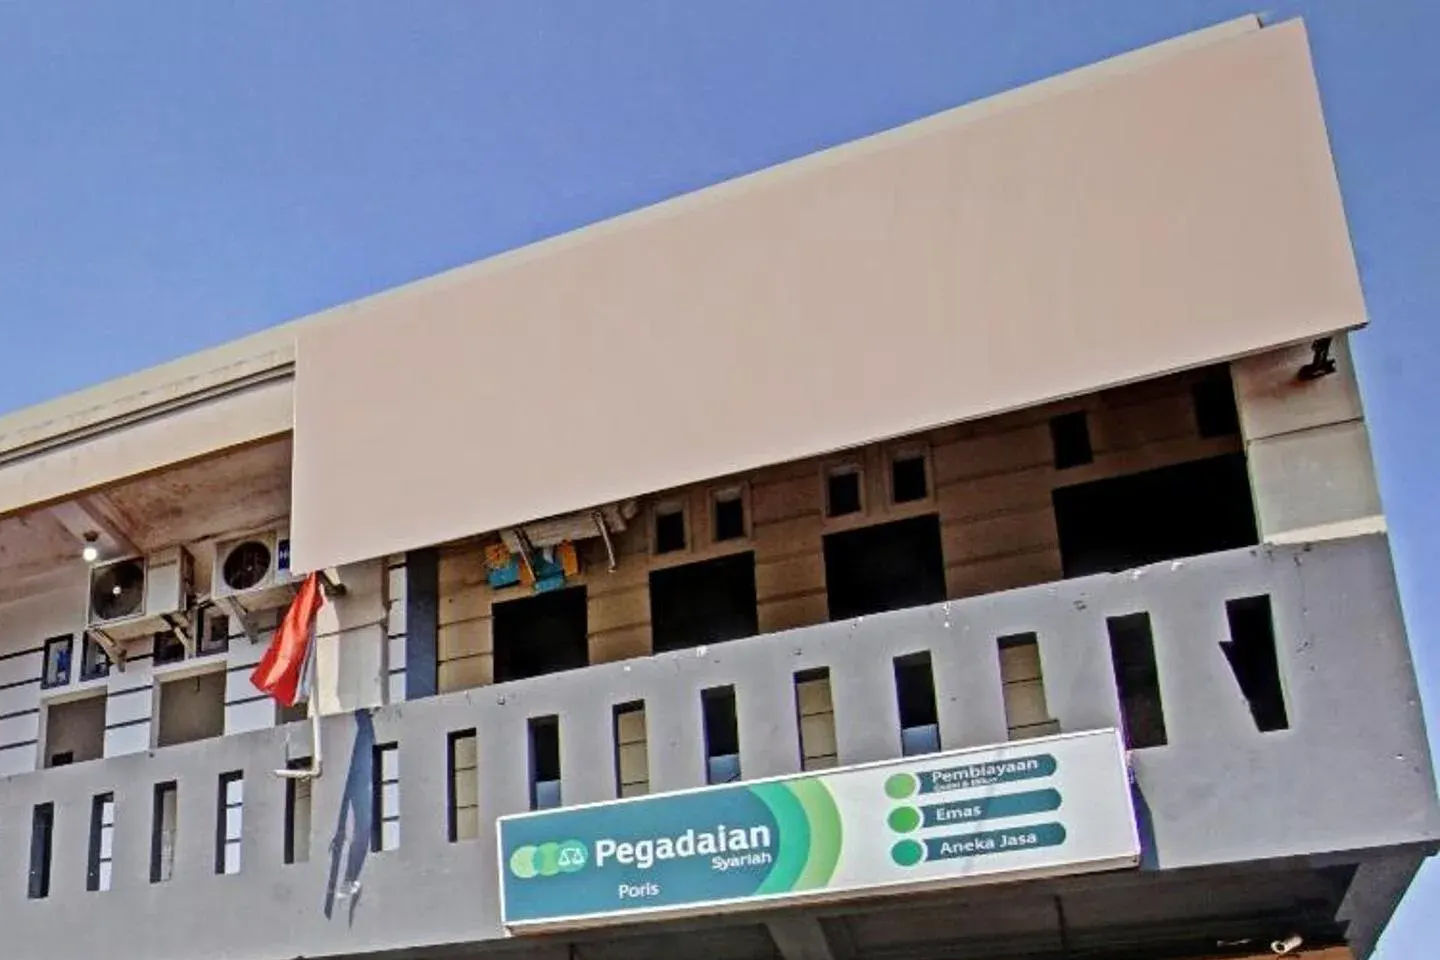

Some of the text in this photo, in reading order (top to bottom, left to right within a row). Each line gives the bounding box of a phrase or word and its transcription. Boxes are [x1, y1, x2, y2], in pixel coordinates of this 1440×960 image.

[932, 759, 1038, 782] Pembiayaan
[936, 806, 981, 821] Emas
[595, 825, 771, 868] Pegadaian
[940, 833, 1037, 854] Aneka Jasa
[712, 852, 772, 870] Syariah
[618, 882, 660, 899] Poris
